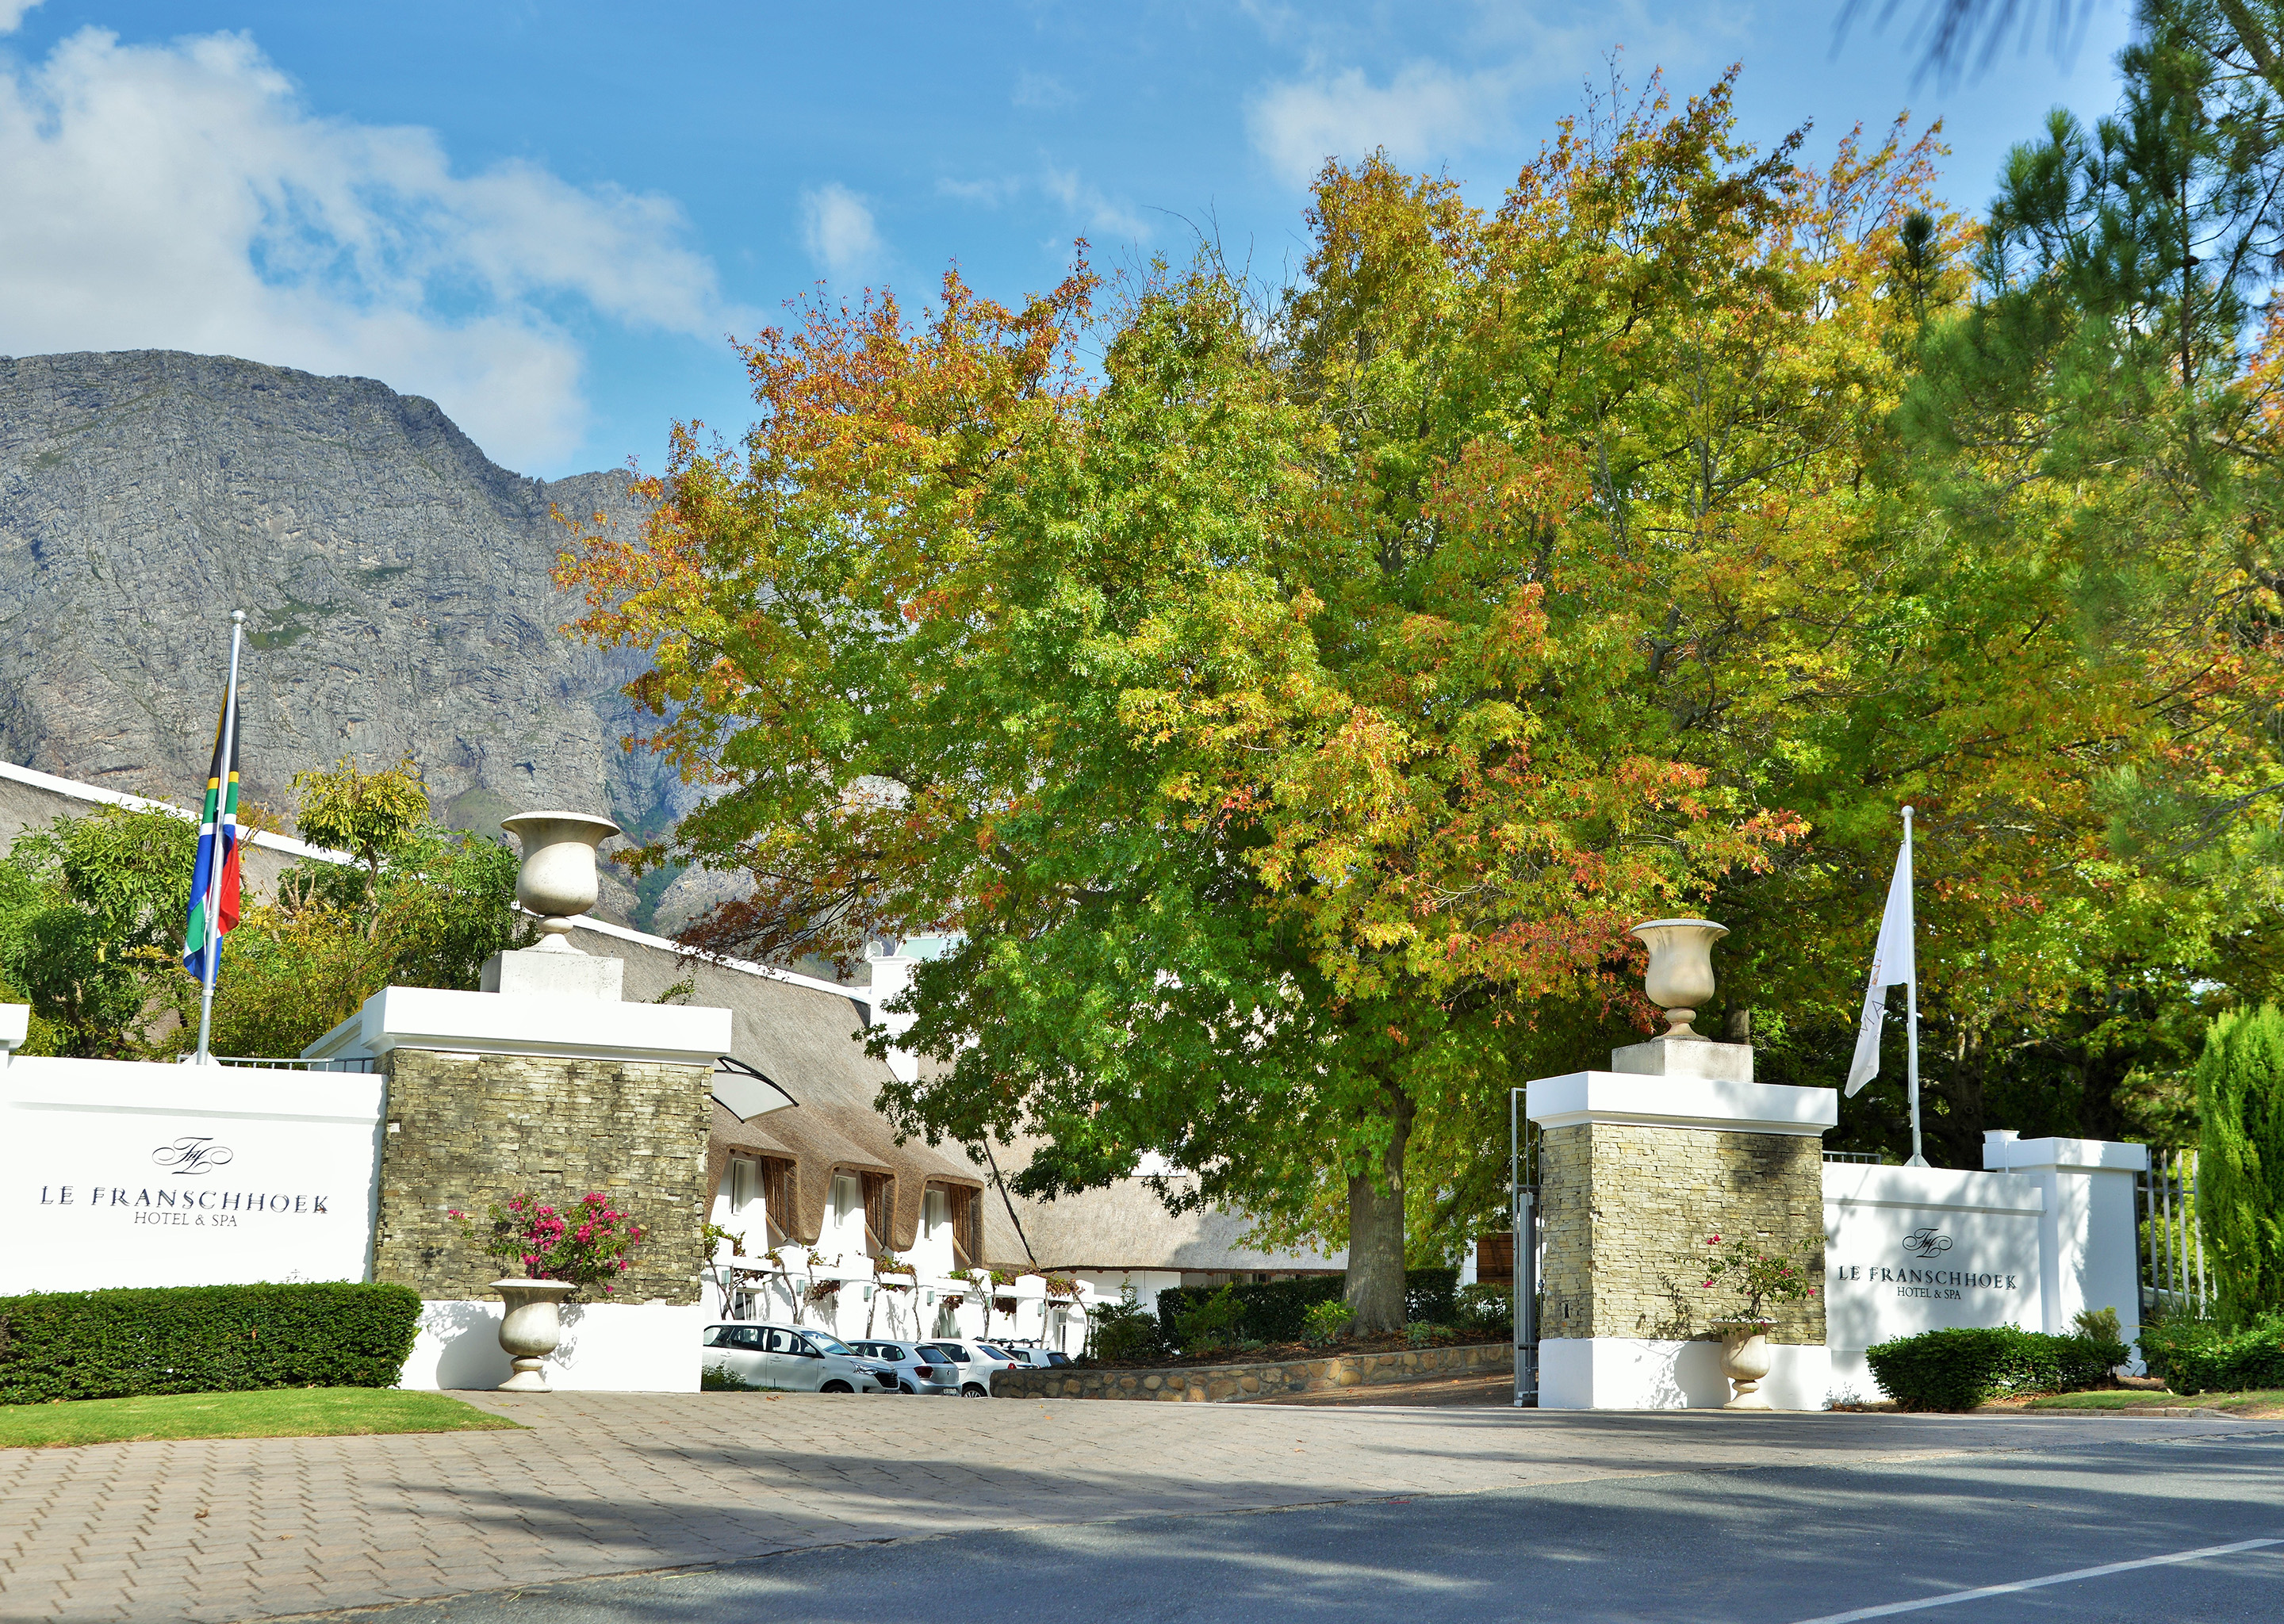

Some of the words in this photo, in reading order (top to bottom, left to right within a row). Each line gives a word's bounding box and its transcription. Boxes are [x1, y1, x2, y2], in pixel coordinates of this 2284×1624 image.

[40, 1185, 75, 1206] LE
[90, 1186, 330, 1216] FRANSCHHOEK
[133, 1211, 190, 1227] HOTEL
[194, 1213, 206, 1227] &
[211, 1213, 239, 1228] SPA
[1838, 1266, 1861, 1281] LE
[1868, 1266, 2018, 1291] FRANSCHHOEK
[1896, 1286, 1932, 1299] HOTEL
[1933, 1289, 1942, 1299] &
[1944, 1289, 1962, 1300] SPA
